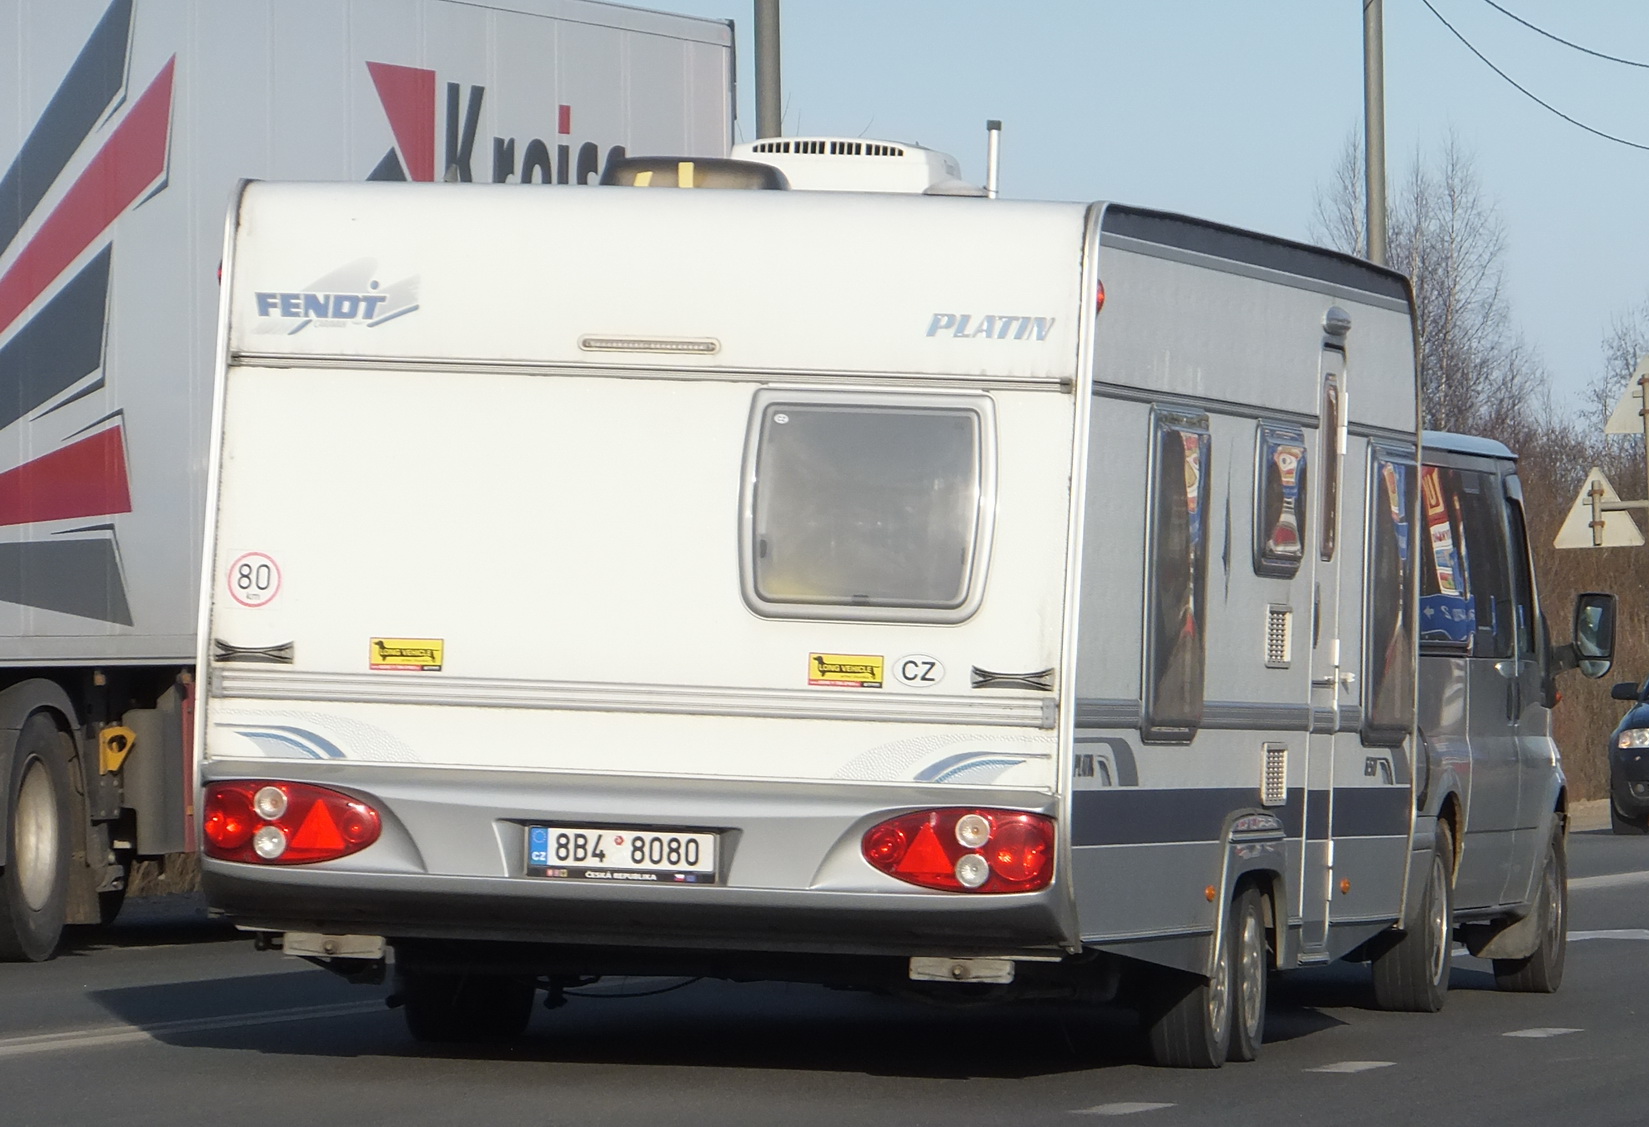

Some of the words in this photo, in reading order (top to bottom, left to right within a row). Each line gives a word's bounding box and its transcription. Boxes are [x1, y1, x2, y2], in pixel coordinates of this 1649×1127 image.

[255, 291, 387, 320] FENDT
[925, 312, 1056, 341] PLATIN
[238, 563, 271, 591] 80
[819, 663, 840, 672] LONG
[841, 665, 872, 673] VEHICLE
[902, 660, 936, 682] CZ
[531, 851, 547, 861] CZ
[555, 832, 606, 863] 8B4
[631, 836, 699, 866] 8080
[585, 870, 611, 880] ČESKÁ
[613, 872, 657, 882] REPUBLIKA
